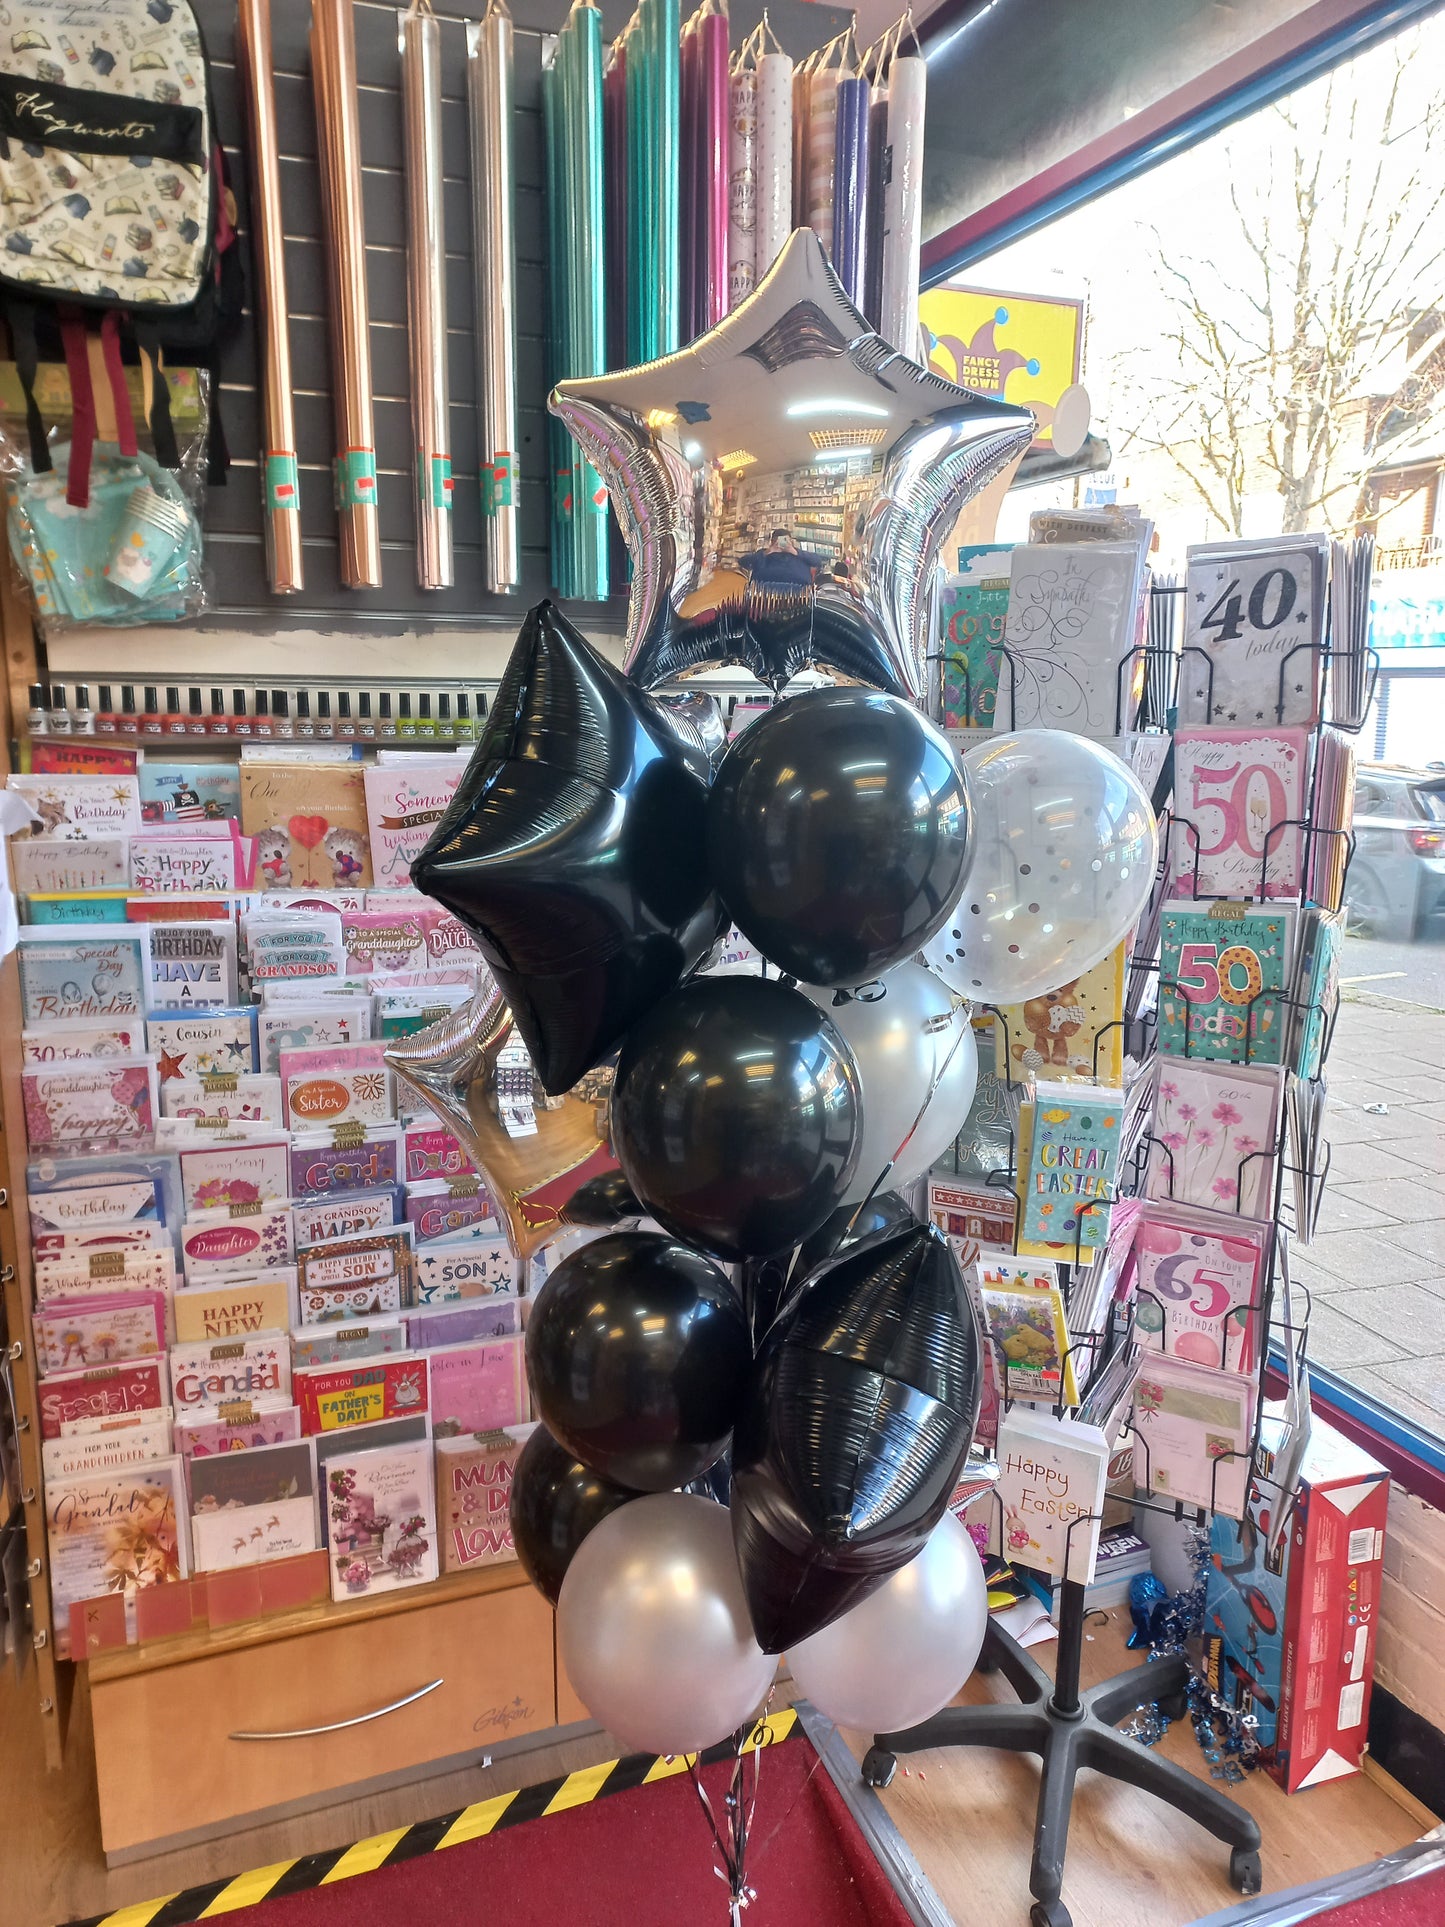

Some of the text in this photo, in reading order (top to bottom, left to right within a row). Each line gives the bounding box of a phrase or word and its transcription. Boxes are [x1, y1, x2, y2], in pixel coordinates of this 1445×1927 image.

[15, 91, 157, 139] Hogwarts
[962, 355, 1000, 367] FANCY
[962, 366, 1000, 377] DRESS
[962, 376, 1000, 390] TOWN
[1067, 521, 1108, 534] DEEPEST
[1062, 554, 1083, 576] In
[1200, 567, 1298, 643] 40
[1245, 630, 1301, 661] today
[56, 751, 117, 766] HAPPY
[1184, 745, 1225, 766] Happy
[1271, 761, 1287, 770] TH
[250, 780, 279, 800] One
[394, 792, 454, 815] Someon
[1185, 760, 1288, 859] 50
[74, 805, 126, 820] Birthday
[403, 811, 446, 828] SPECIA
[382, 830, 429, 850] Wishing
[158, 855, 211, 876] Happy
[1222, 856, 1281, 880] Birthday
[50, 905, 105, 921] Birthday
[1210, 909, 1241, 919] REGAL
[155, 928, 212, 938] ENJOY YOUR
[271, 935, 290, 945] FOR
[1181, 919, 1266, 945] Happy Birthday
[73, 944, 118, 962] Special
[150, 938, 224, 956] BIRTHDAY
[345, 937, 420, 952] Granddaughter
[277, 953, 295, 961] FOR
[435, 957, 474, 968] SENDING
[97, 959, 123, 977] Day
[152, 963, 222, 982] HAVE
[255, 963, 338, 978] GRANDSON
[1174, 943, 1264, 1007] 50
[181, 984, 192, 997] A
[176, 1026, 223, 1042] Cousin
[28, 1046, 55, 1062] 30
[41, 1080, 112, 1097] Granddaughter
[206, 1081, 233, 1090] REGAL
[299, 1094, 343, 1112] Sister
[61, 1112, 129, 1135] happy
[335, 1141, 361, 1149] REGAL
[1063, 1132, 1087, 1142] Have
[1041, 1144, 1110, 1171] GREAT
[451, 1187, 476, 1197] REGAL
[1035, 1172, 1110, 1200] EASTER
[58, 1199, 127, 1217] Birthday
[231, 1205, 258, 1216] REGAL
[324, 1206, 380, 1221] GRANDSON
[309, 1215, 381, 1243] HAPPY
[191, 1234, 253, 1256] Daughter
[92, 1255, 121, 1264] REGAL
[318, 1253, 381, 1270] HAPPY BIRTHDAY
[462, 1254, 482, 1263] Special
[1205, 1255, 1243, 1273] ON YOUR
[92, 1266, 121, 1275] REGAL
[343, 1262, 377, 1279] SON
[442, 1261, 487, 1282] SON
[55, 1279, 95, 1290] Wishing
[106, 1272, 151, 1285] wonderful
[1153, 1253, 1232, 1318] 65
[1231, 1278, 1242, 1289] TH
[202, 1301, 265, 1322] HAPPY
[204, 1314, 265, 1340] NEW
[340, 1329, 364, 1338] REGAL
[213, 1348, 240, 1357] REGAL
[87, 1369, 115, 1377] REGAL
[314, 1369, 387, 1391] FOR YOU DAD
[175, 1363, 281, 1404] Grandad
[344, 1390, 356, 1399] ON
[321, 1394, 382, 1415] FATHER'S
[229, 1415, 256, 1425] REGAL
[336, 1406, 368, 1423] DAY!
[84, 1441, 121, 1455] FROM YOUR
[62, 1449, 145, 1473] GRANDCHILDREN
[1114, 1451, 1134, 1474] 18
[1005, 1453, 1070, 1498] Happy
[461, 1492, 482, 1514] &
[1020, 1488, 1096, 1527] Easter!
[1281, 1703, 1291, 1741] DELUXE
